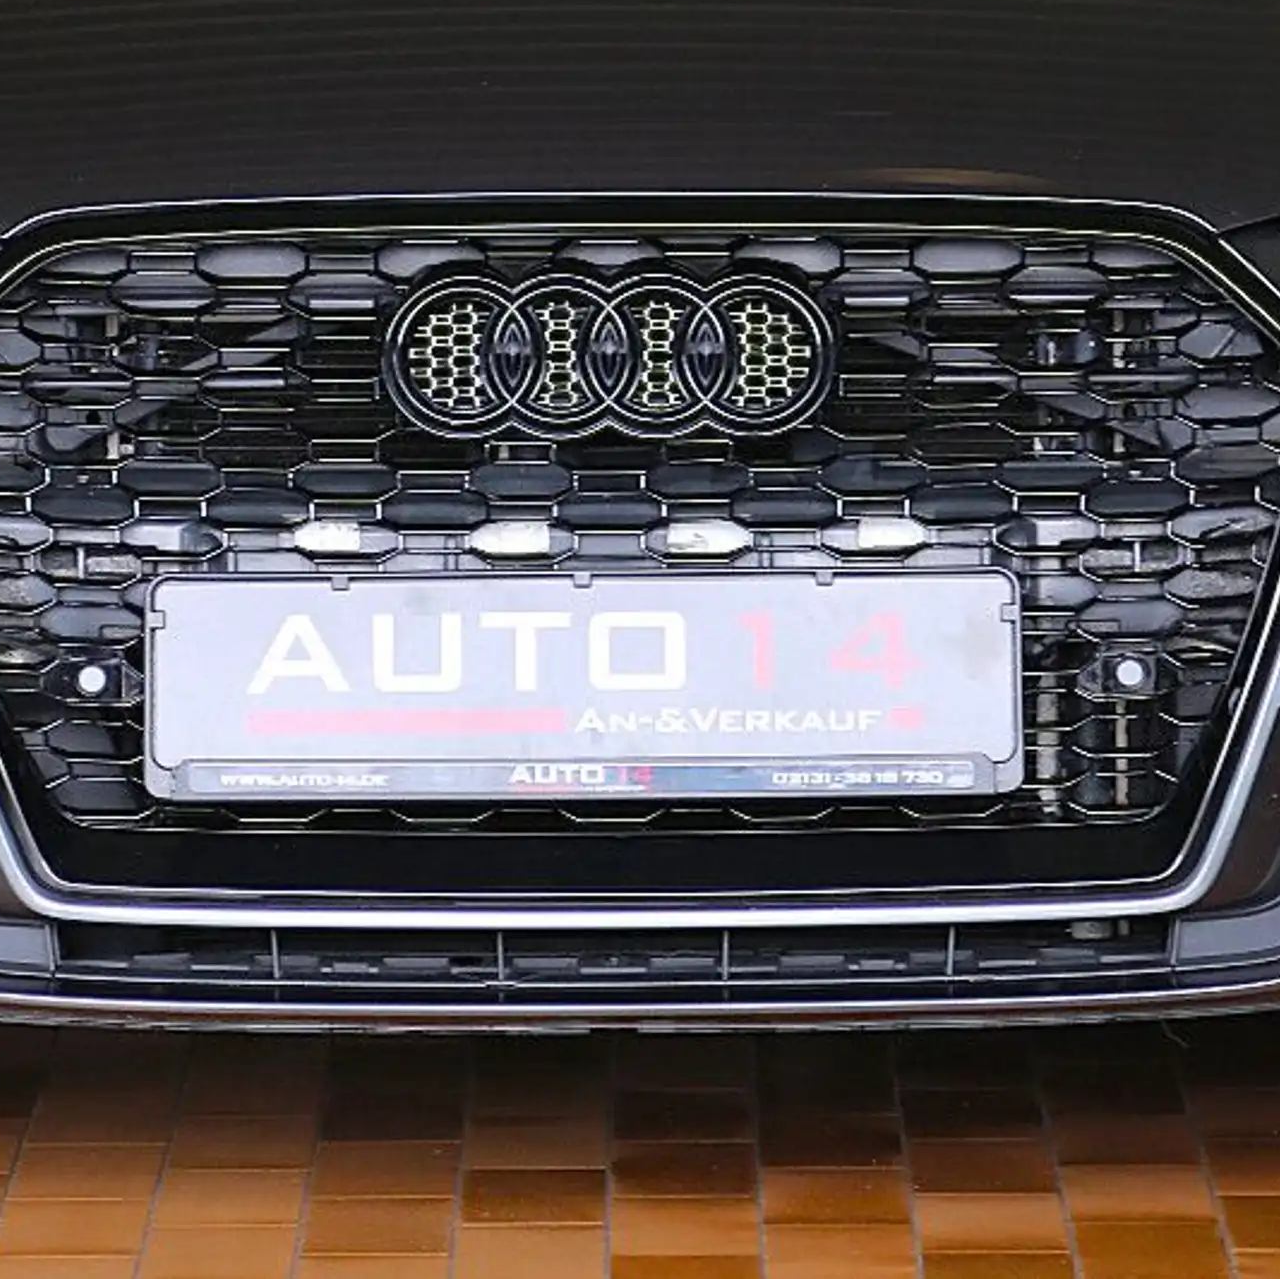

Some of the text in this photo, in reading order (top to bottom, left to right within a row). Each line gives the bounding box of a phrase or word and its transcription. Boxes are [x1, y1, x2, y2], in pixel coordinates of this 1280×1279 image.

[246, 609, 928, 695] AUTO 14
[508, 765, 605, 784] AUTO
